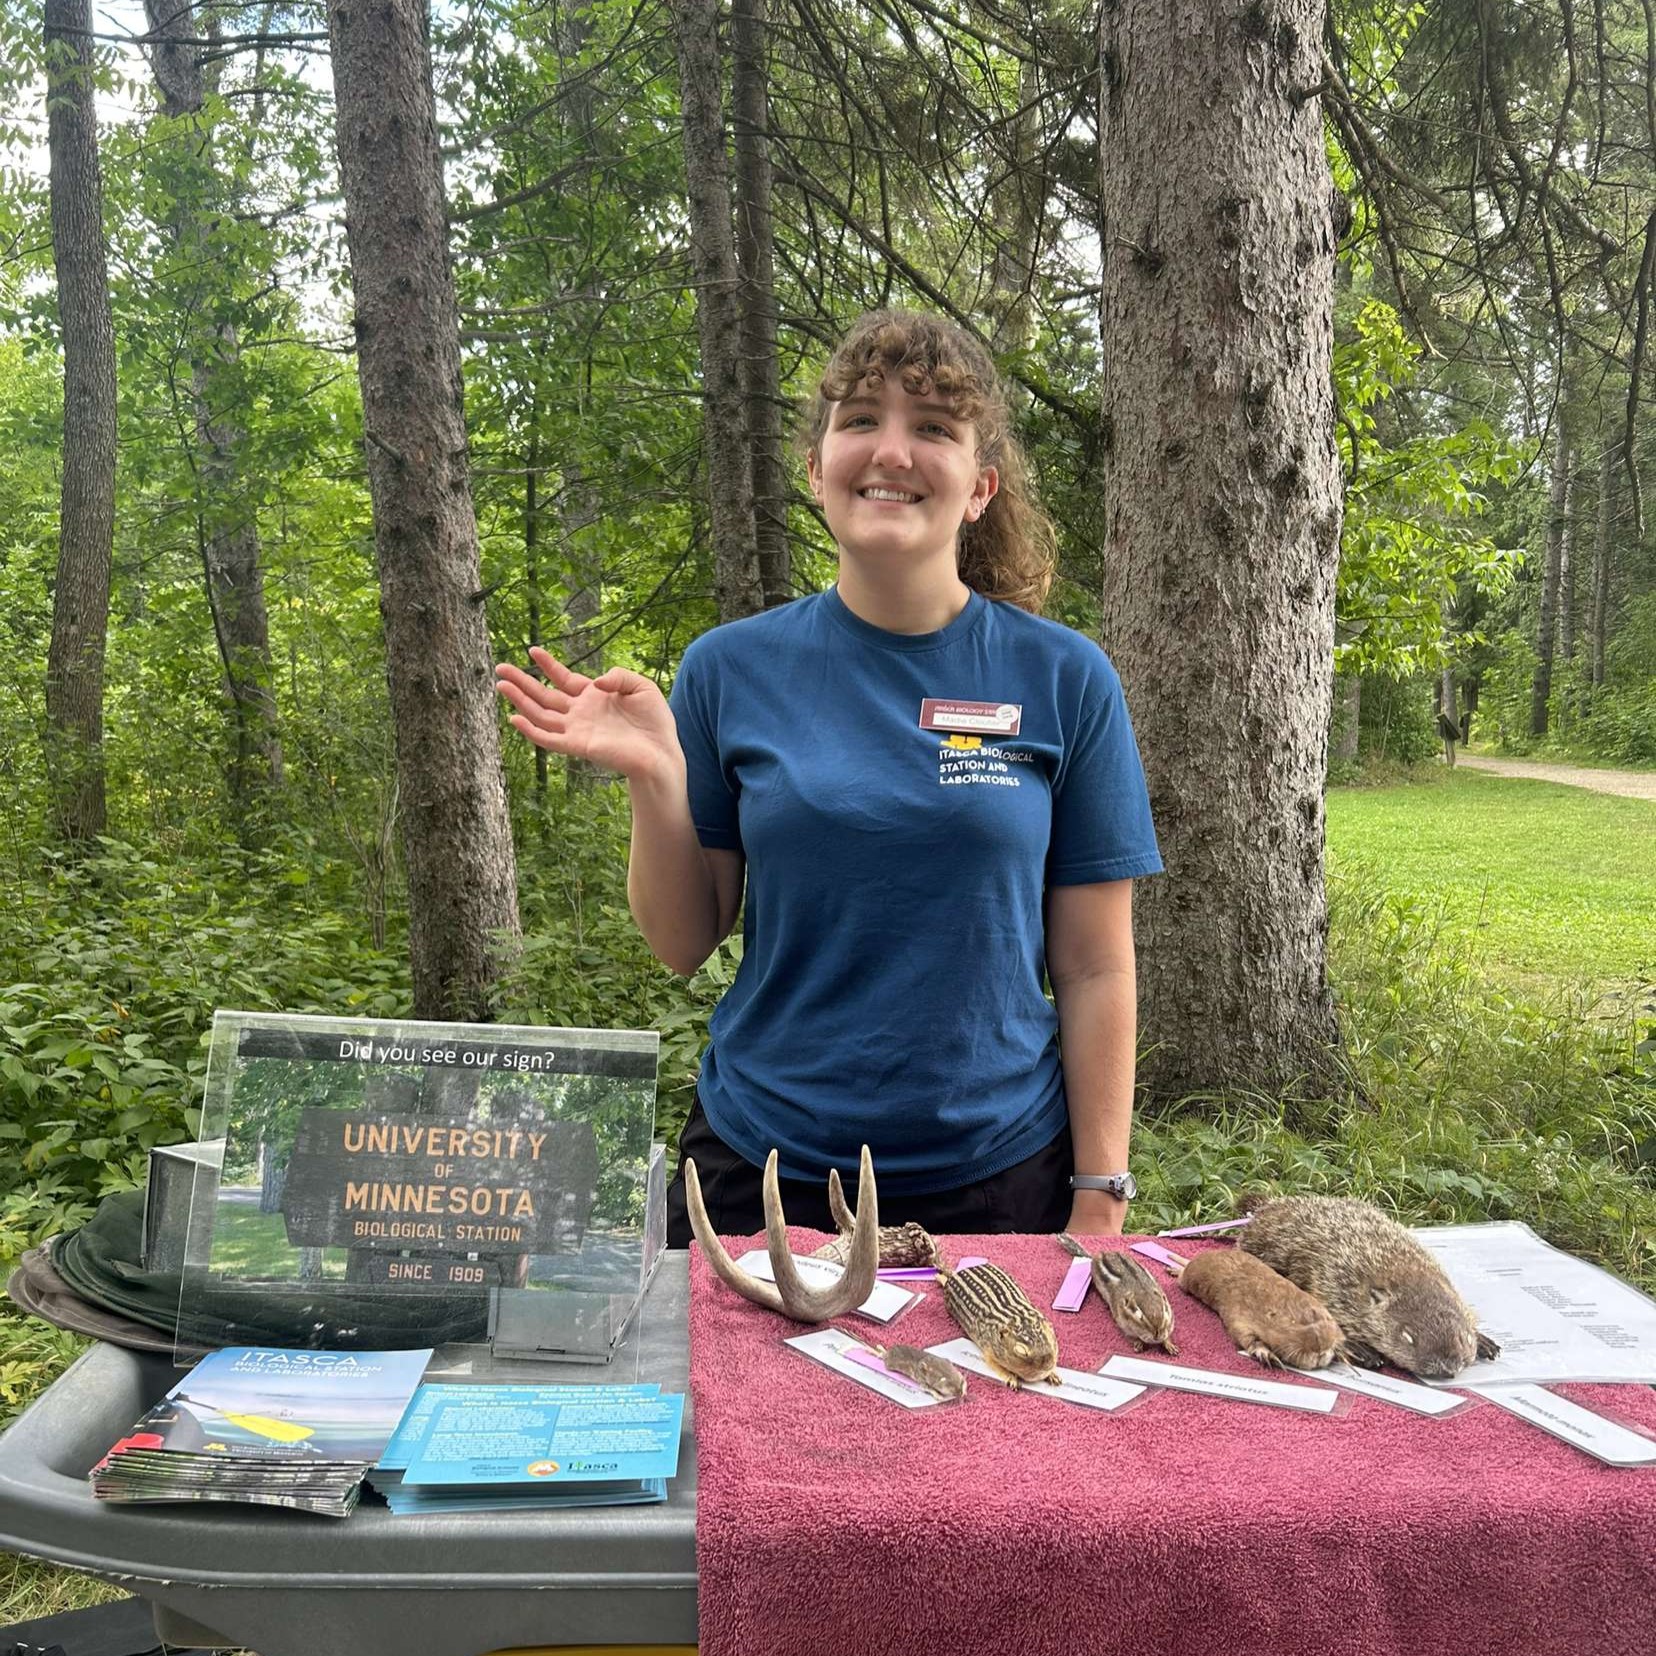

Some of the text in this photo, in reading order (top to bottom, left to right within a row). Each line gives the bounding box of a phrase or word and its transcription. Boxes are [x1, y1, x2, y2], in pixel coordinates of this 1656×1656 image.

[981, 747, 1034, 762] BIOLOGICAL
[939, 760, 1009, 773] STATION AND
[939, 774, 1020, 787] LABORATORIES
[339, 1040, 555, 1072] Did you see our sign?
[343, 1122, 548, 1160] UNIVERSITY
[434, 1163, 455, 1179] OF
[344, 1181, 535, 1217] MINNESOTA
[354, 1221, 522, 1242] BIOLOGICAL STATION
[388, 1263, 484, 1283] SINCE 1909
[241, 1351, 359, 1366] ITASCA
[229, 1366, 370, 1378] AND LABORATORIES
[234, 1360, 383, 1373] BIOLOGICAL STATION
